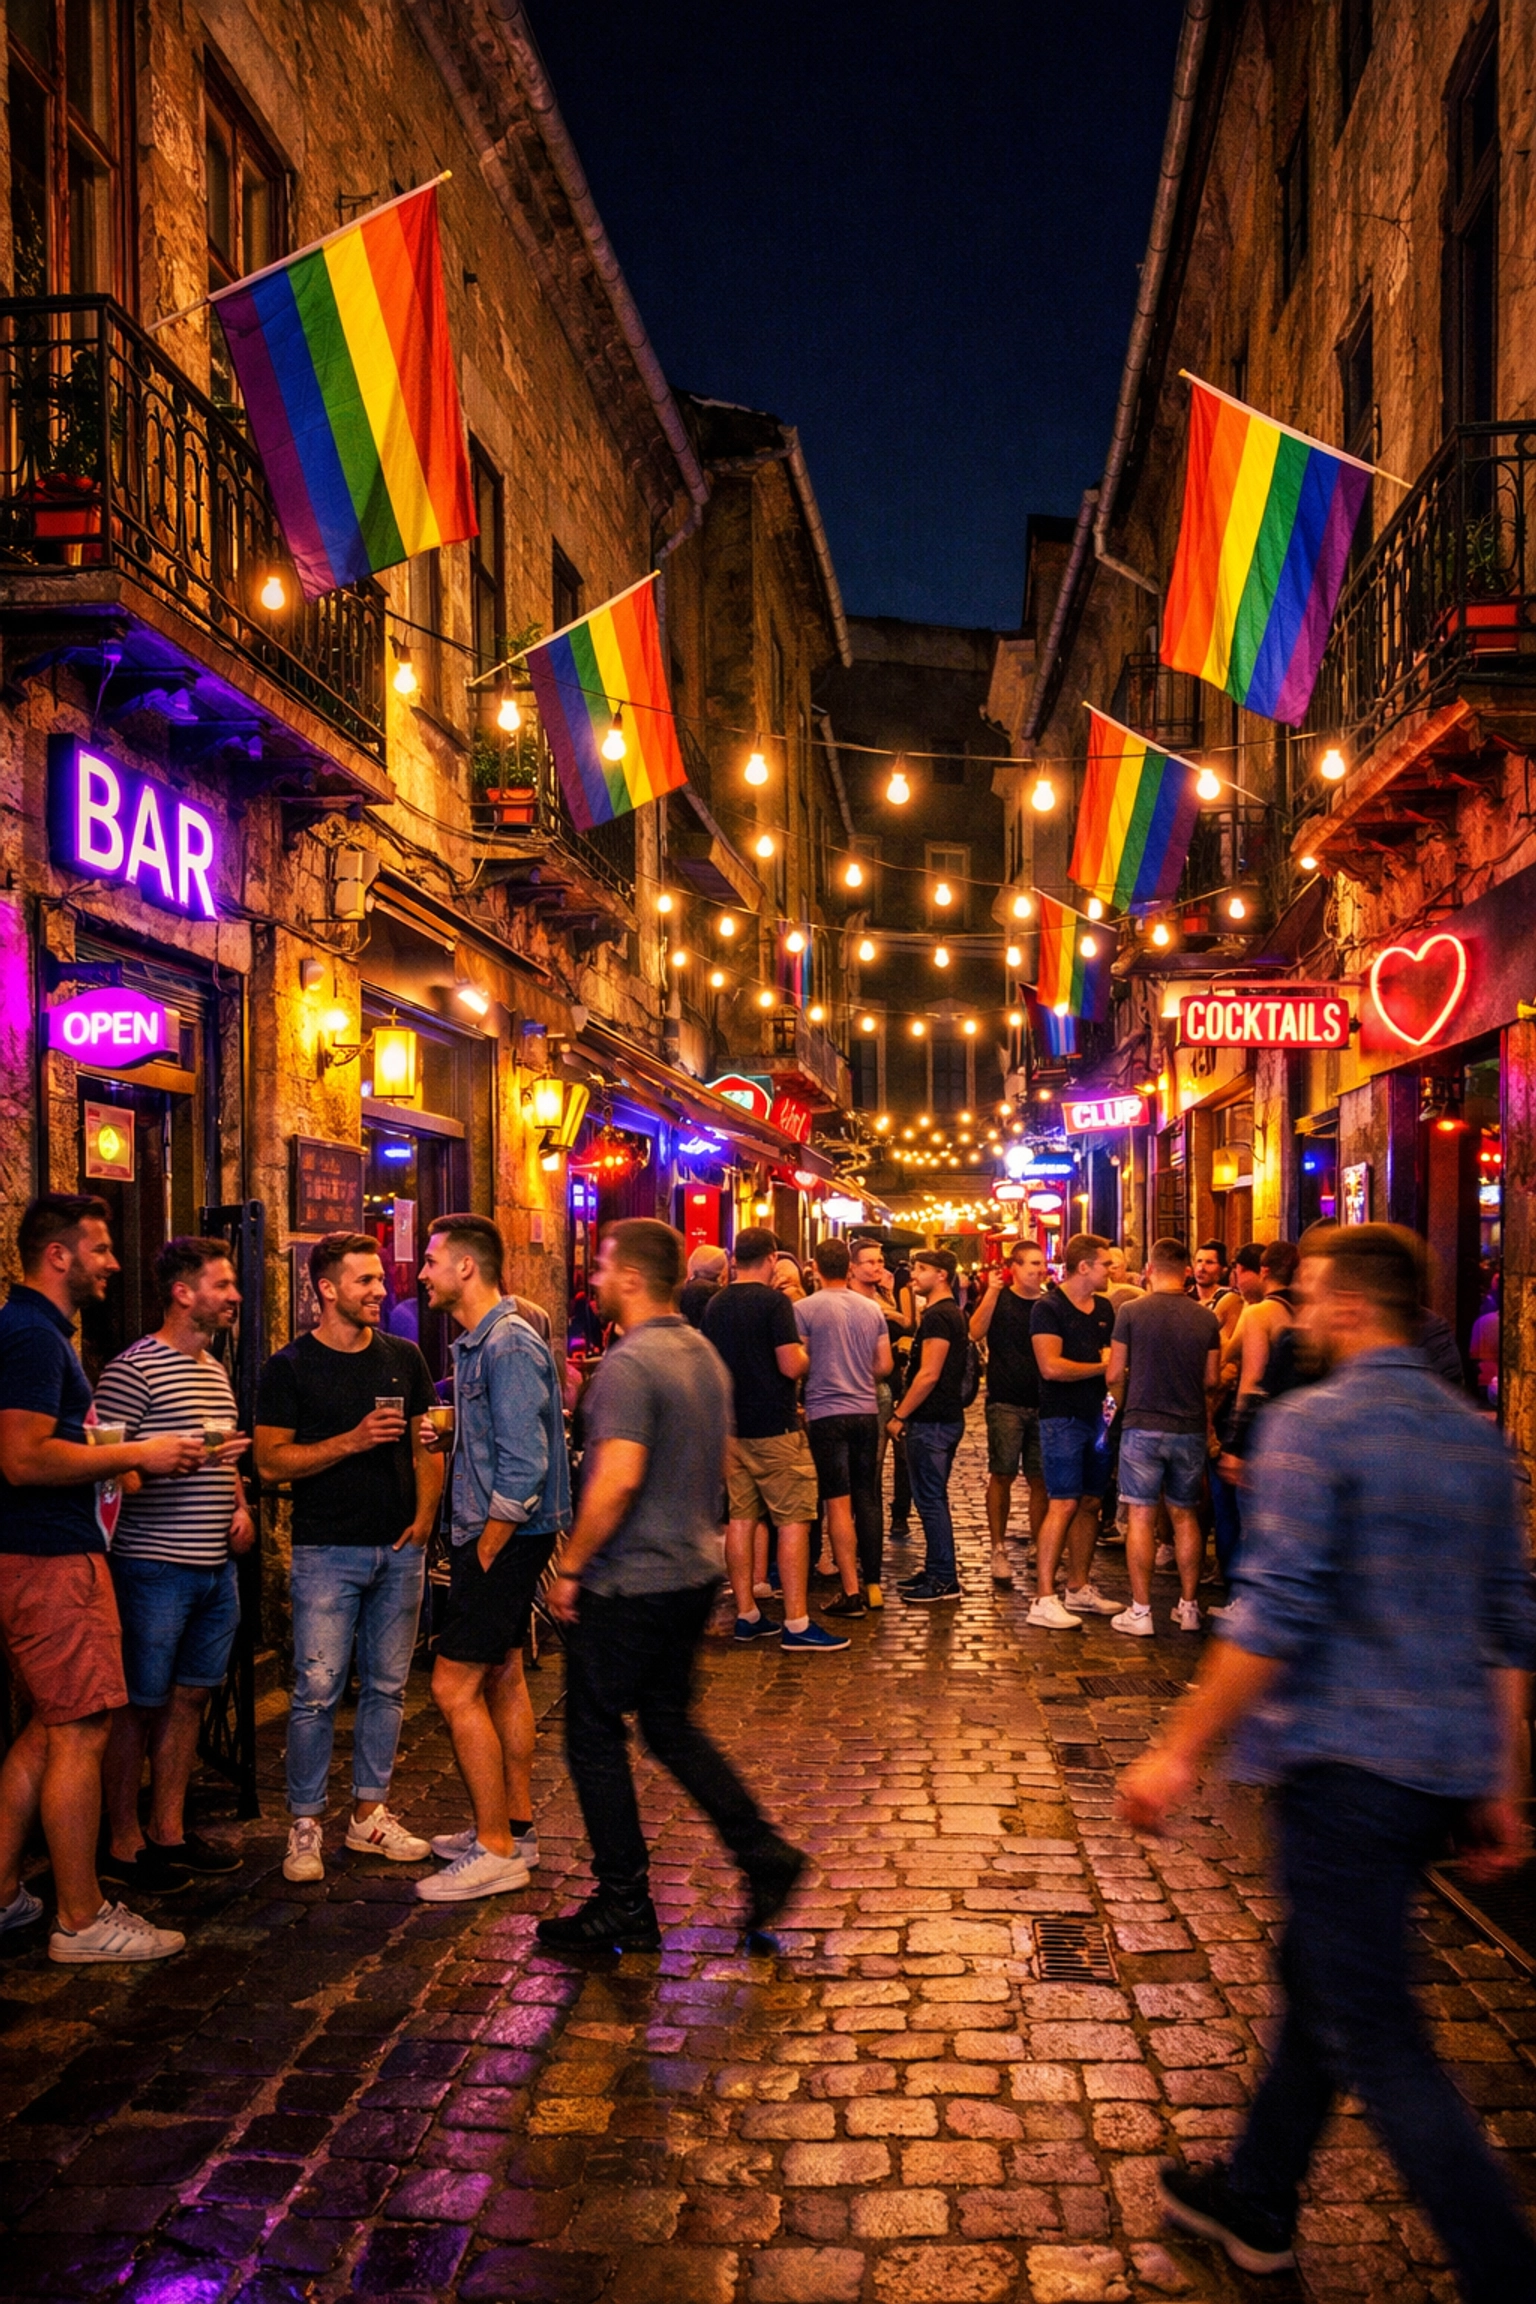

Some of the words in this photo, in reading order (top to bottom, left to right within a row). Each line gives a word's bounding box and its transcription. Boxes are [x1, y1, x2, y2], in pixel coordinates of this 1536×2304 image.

[79, 750, 218, 920] BAR
[63, 1011, 158, 1045] OPEN
[1186, 1001, 1341, 1042] COCKTAILS
